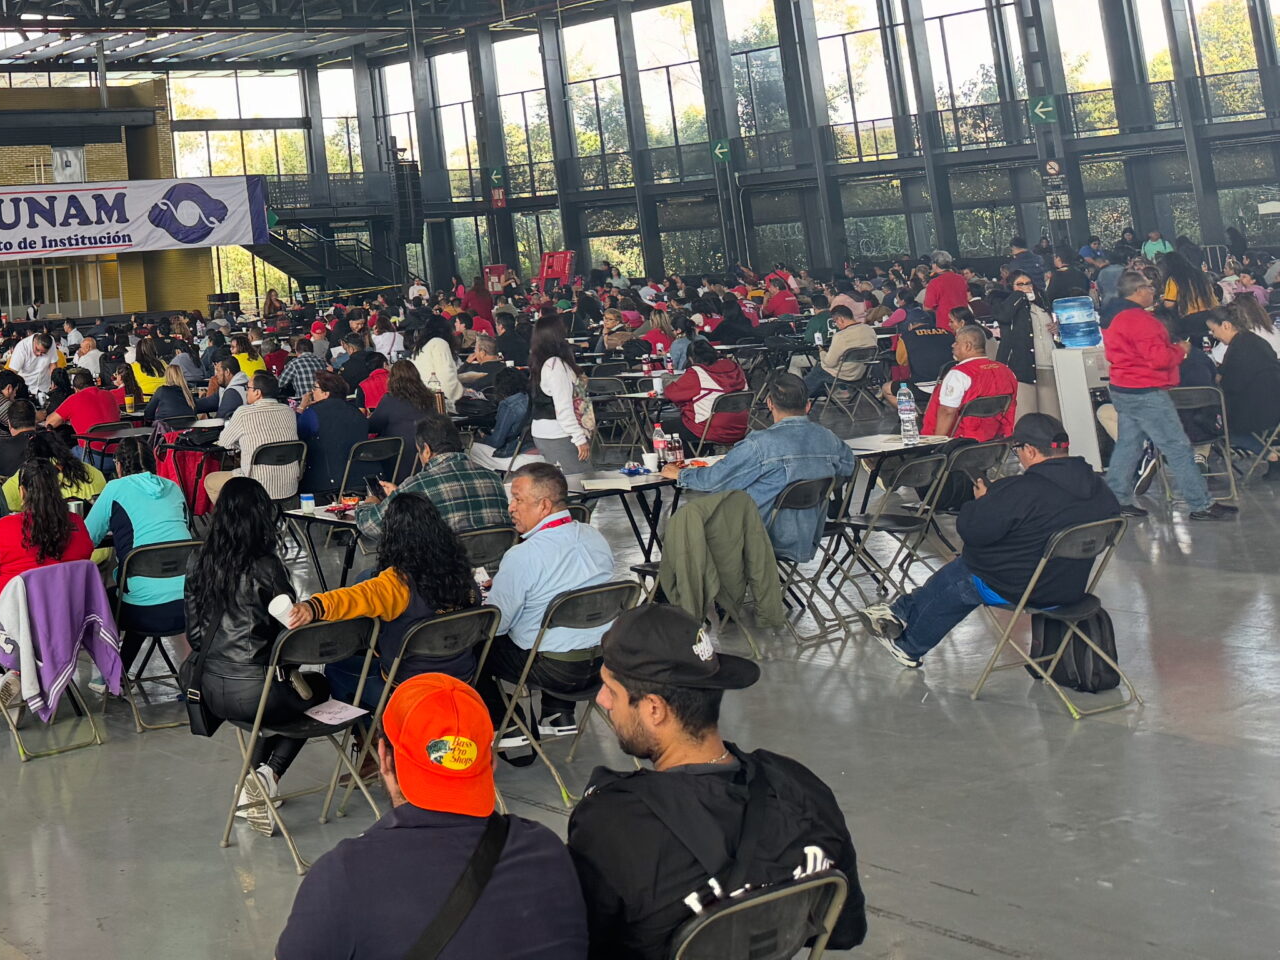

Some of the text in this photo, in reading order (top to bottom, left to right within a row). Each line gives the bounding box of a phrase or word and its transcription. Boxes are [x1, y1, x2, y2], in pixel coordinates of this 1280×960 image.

[18, 237, 37, 250] de
[41, 231, 133, 249] Institución
[452, 736, 473, 747] Bass
[451, 746, 467, 756] Pro
[451, 755, 473, 766] Shops
